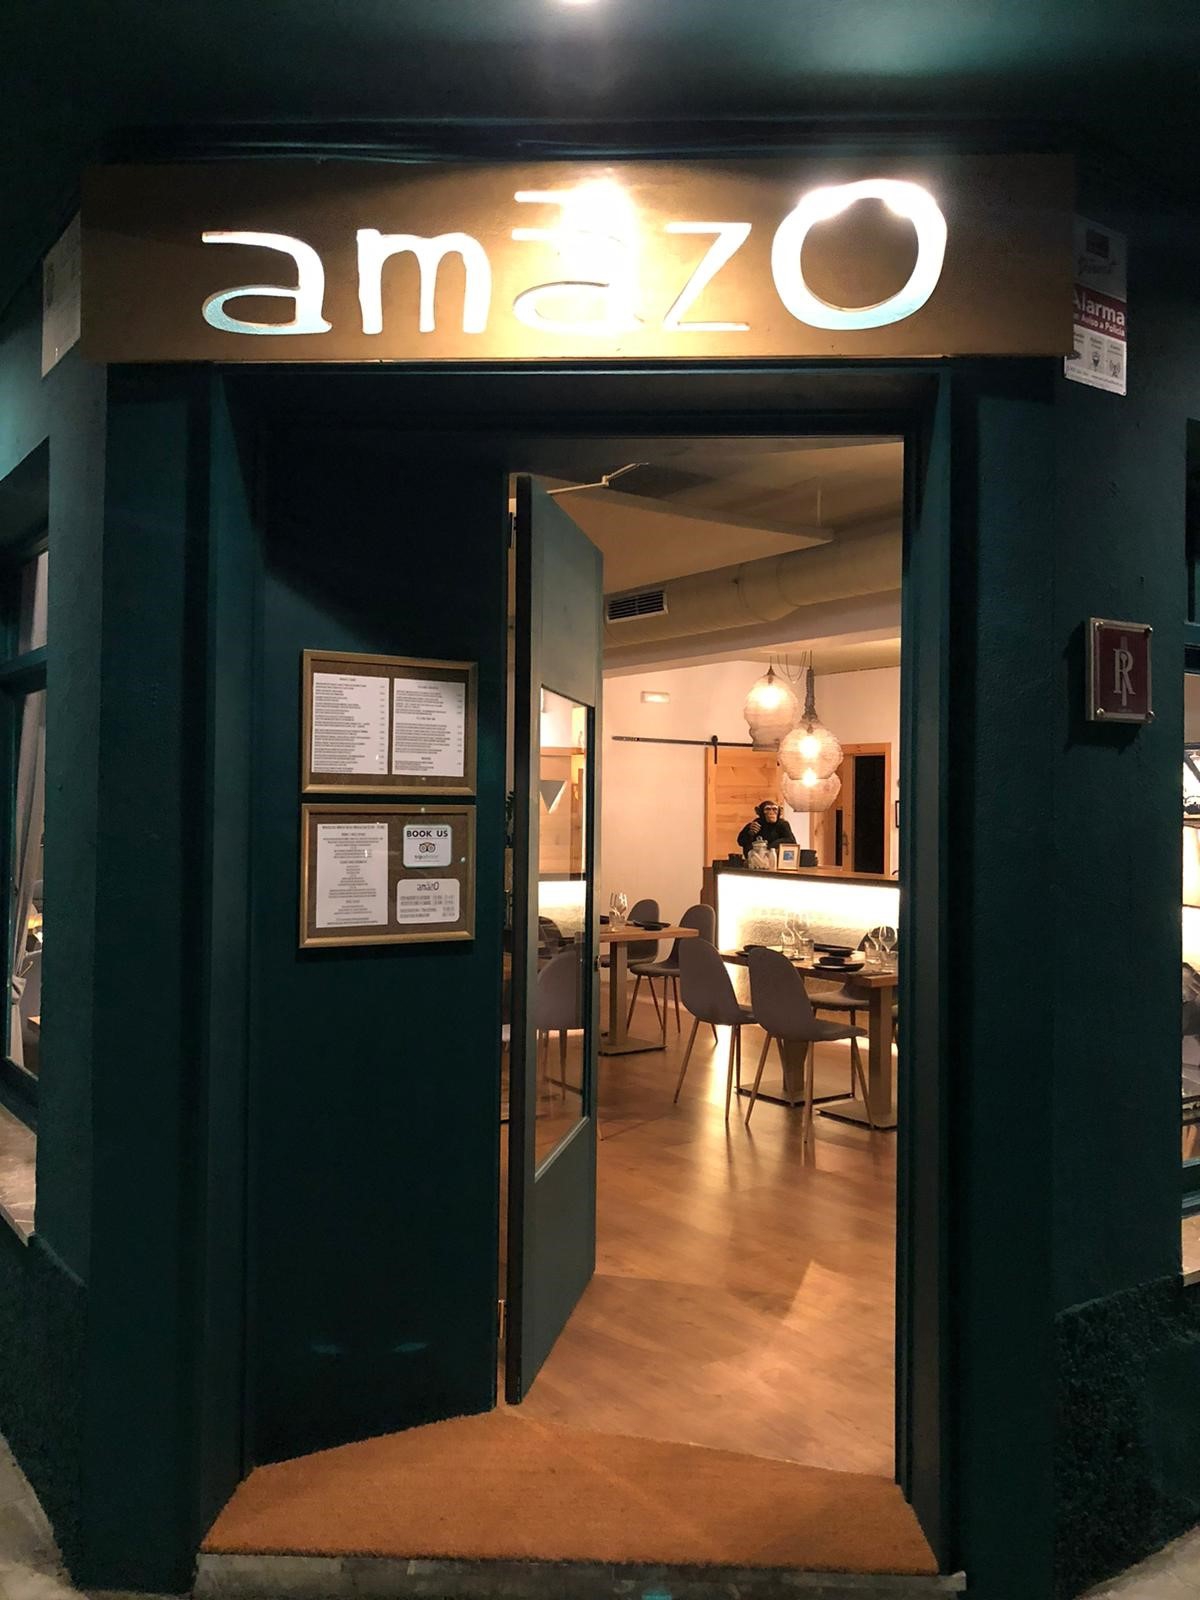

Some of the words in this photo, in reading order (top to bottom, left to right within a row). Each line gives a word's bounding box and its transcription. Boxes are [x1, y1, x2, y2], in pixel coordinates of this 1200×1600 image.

[1072, 288, 1125, 326] Alarma
[406, 830, 432, 838] BOOK
[436, 830, 449, 838] US
